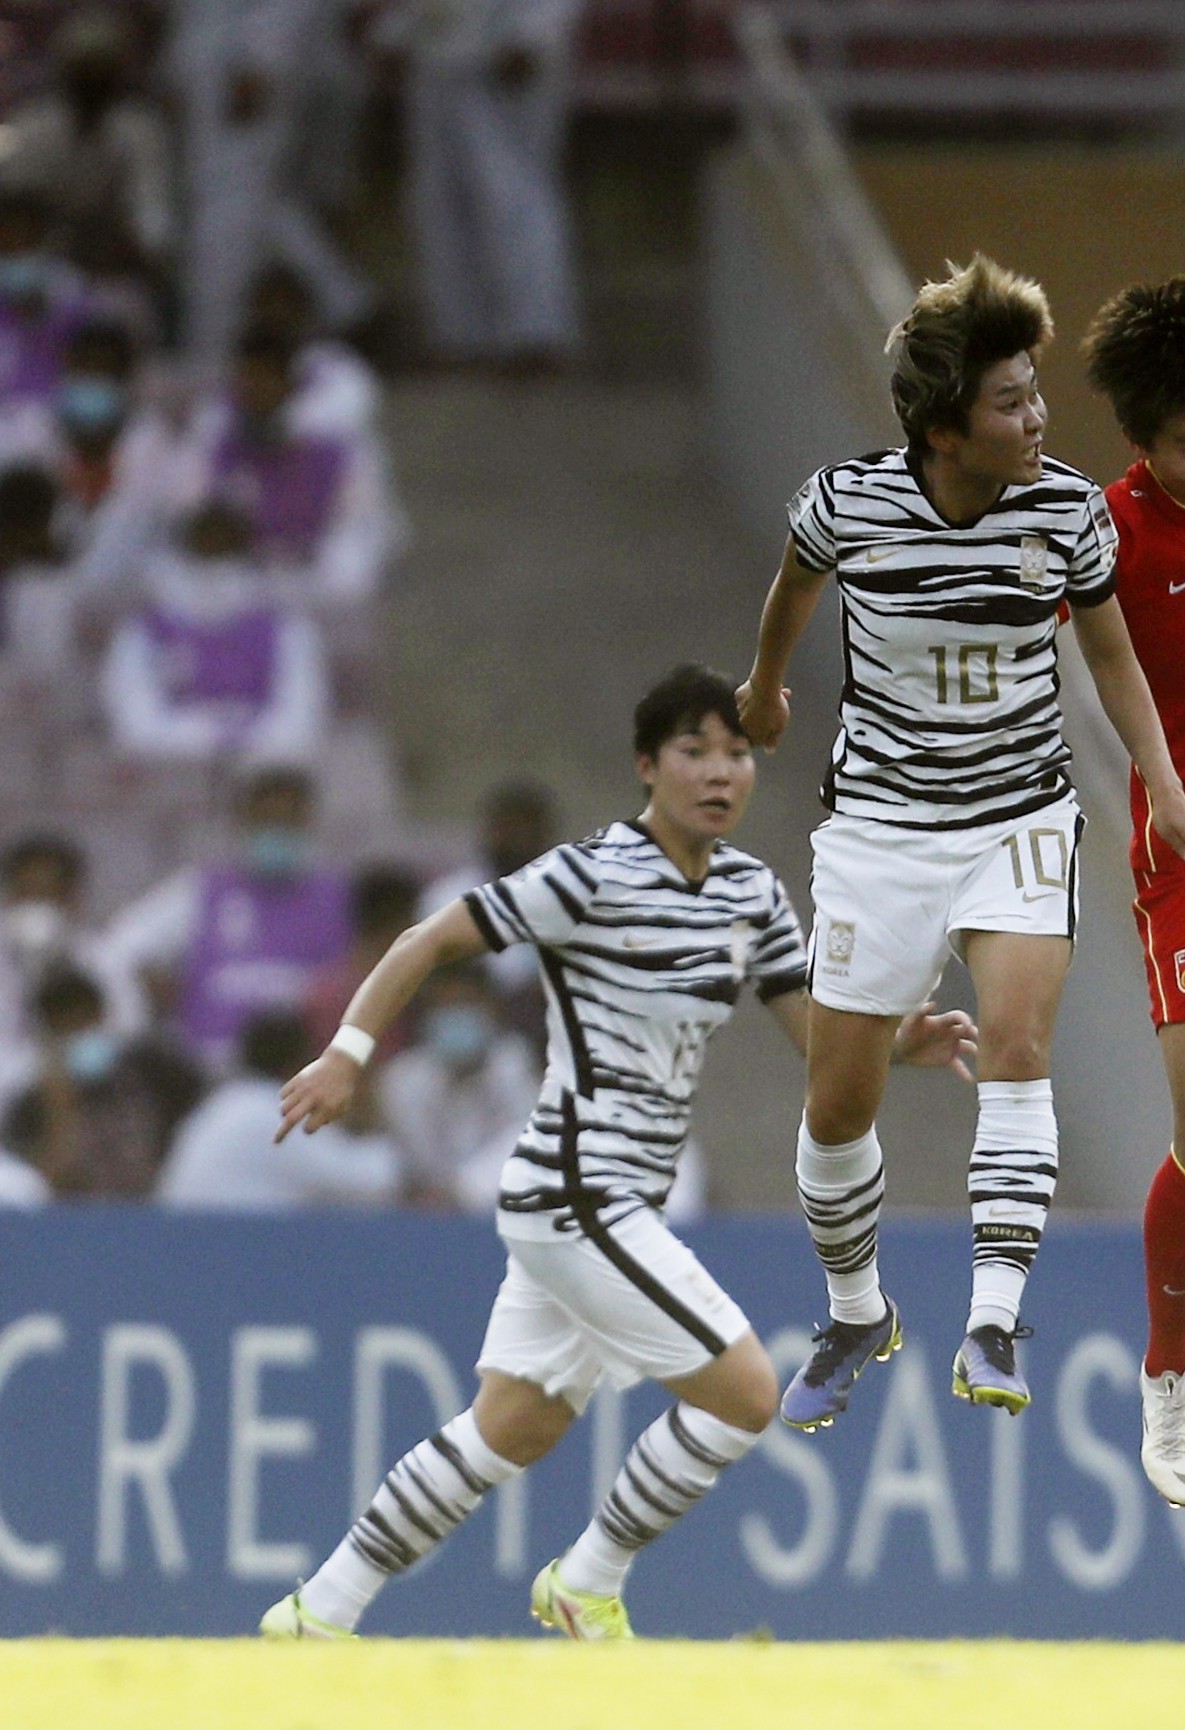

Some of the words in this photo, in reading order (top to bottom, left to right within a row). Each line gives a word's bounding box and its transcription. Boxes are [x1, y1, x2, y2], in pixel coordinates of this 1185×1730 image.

[928, 643, 1000, 705] 10
[1001, 827, 1068, 891] 10
[981, 1225, 1035, 1241] KOREA
